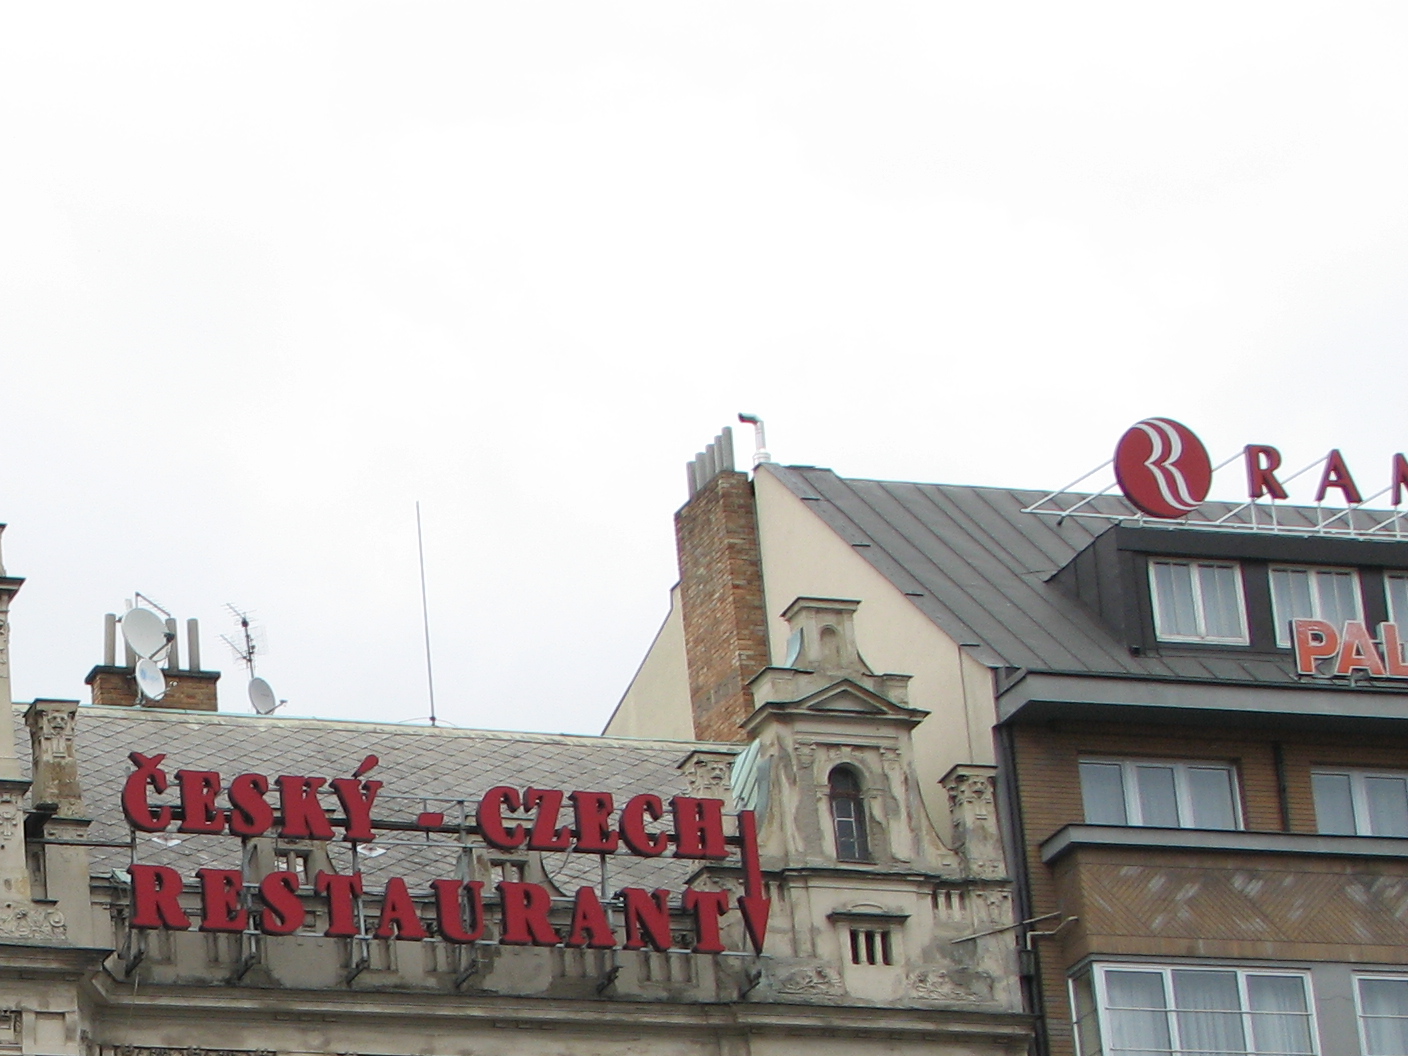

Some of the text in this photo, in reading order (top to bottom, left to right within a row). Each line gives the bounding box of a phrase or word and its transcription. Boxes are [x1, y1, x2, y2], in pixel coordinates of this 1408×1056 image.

[121, 752, 384, 842] ČESKÝ
[476, 785, 730, 860] CZECH
[126, 863, 730, 955] RESTAURANT
